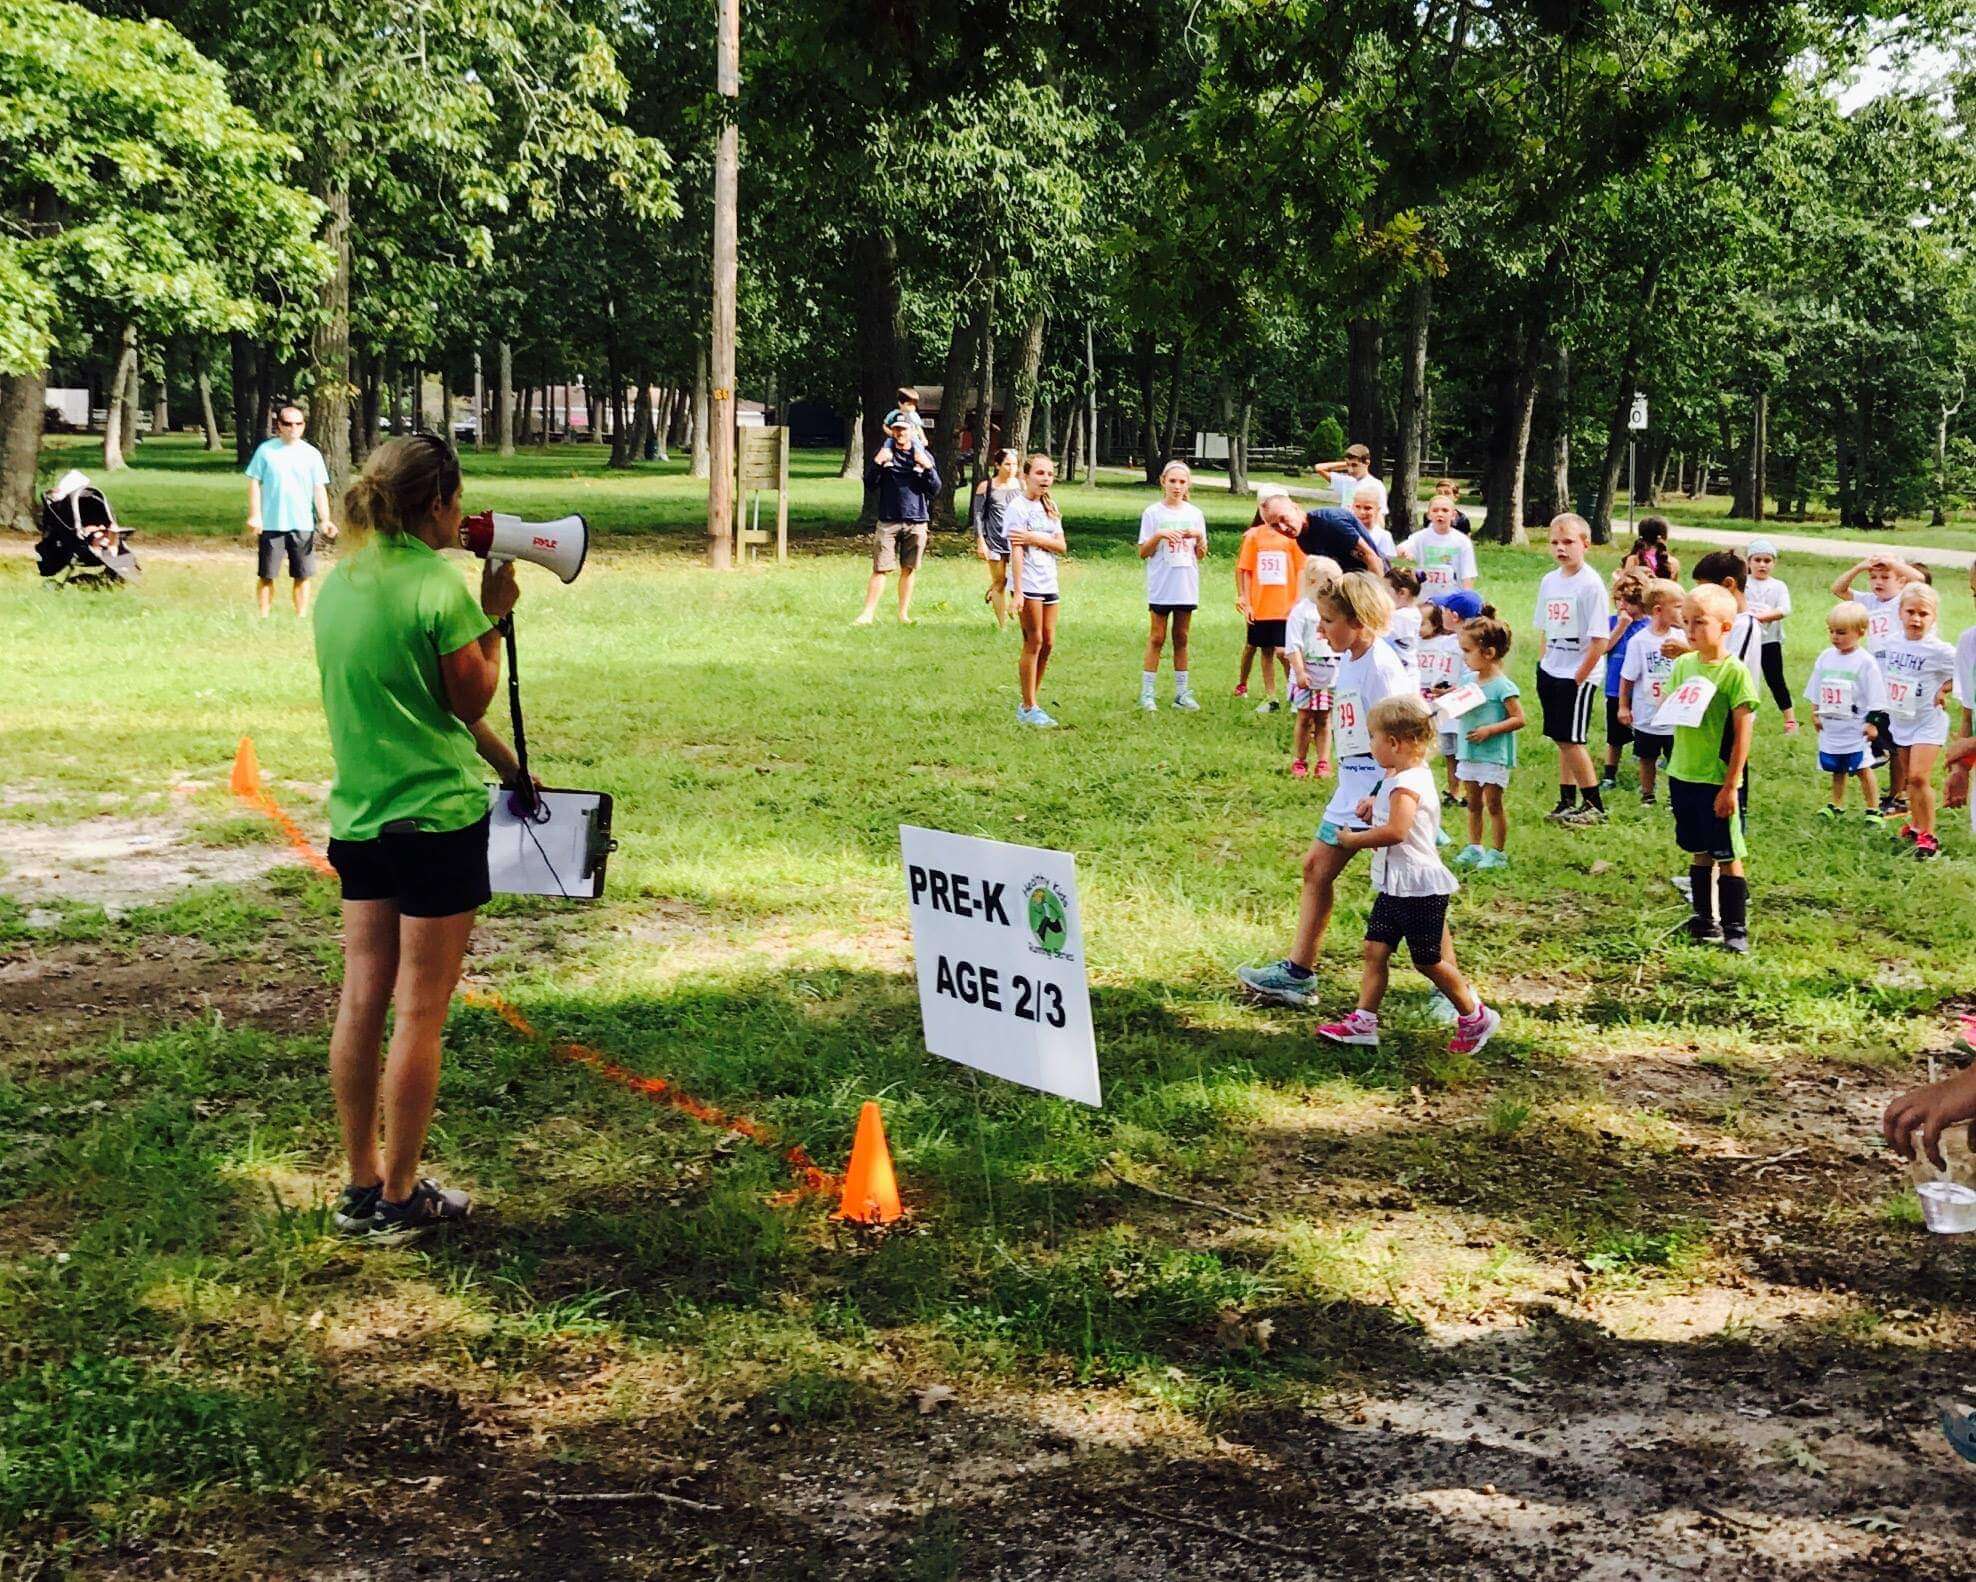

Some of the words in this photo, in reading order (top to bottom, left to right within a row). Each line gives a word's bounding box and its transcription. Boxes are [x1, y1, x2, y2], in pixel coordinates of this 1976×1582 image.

[1261, 558, 1280, 571] 551
[909, 864, 1011, 927] PRE-K
[936, 954, 1003, 1012] AGE
